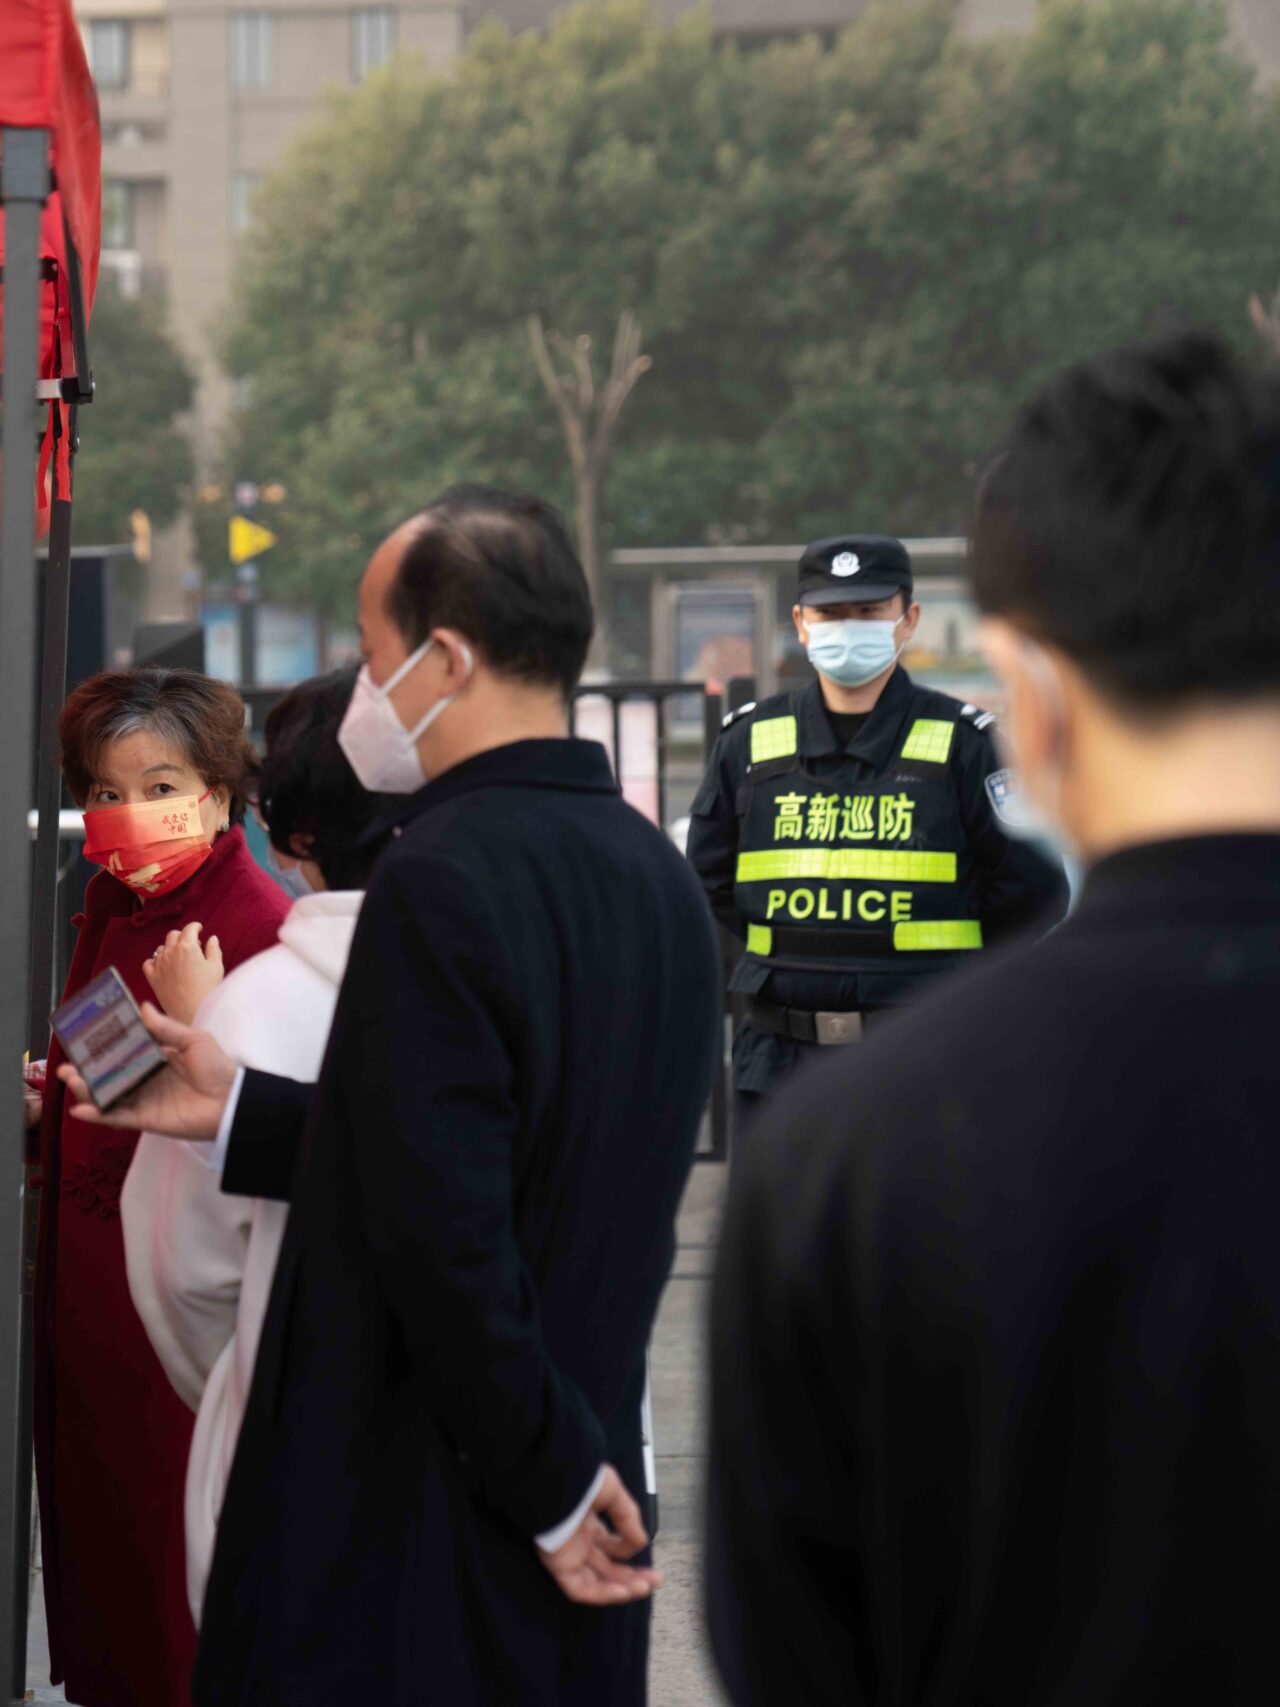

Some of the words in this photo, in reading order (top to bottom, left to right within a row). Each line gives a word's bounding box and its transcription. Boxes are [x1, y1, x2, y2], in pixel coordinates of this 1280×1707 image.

[162, 813, 189, 824] 我爱你
[774, 792, 915, 841] 高新巡防
[168, 823, 187, 834] 中国
[766, 888, 913, 922] POLICE
